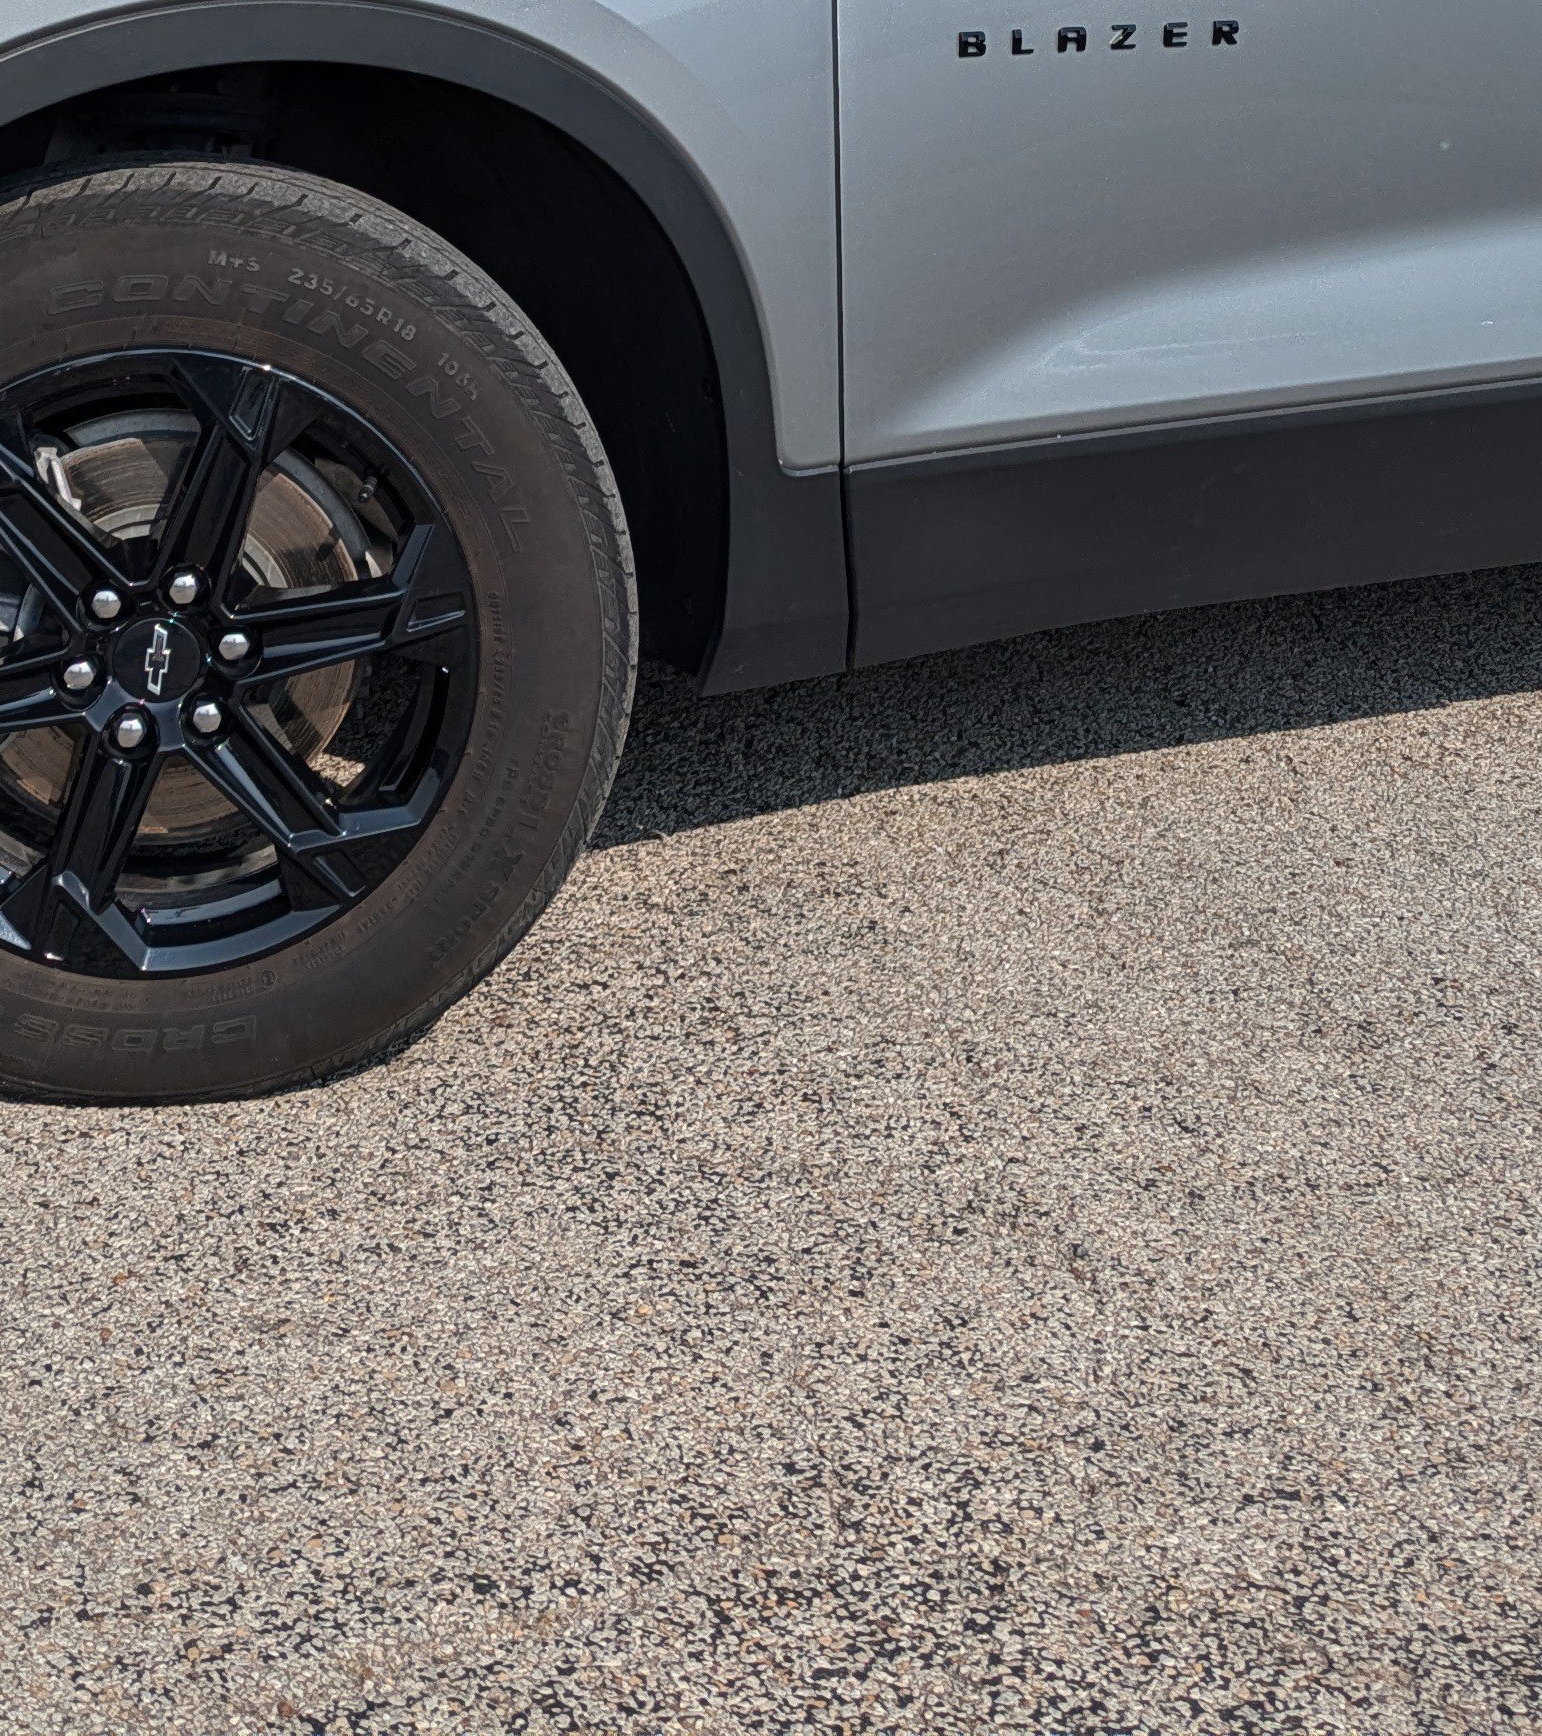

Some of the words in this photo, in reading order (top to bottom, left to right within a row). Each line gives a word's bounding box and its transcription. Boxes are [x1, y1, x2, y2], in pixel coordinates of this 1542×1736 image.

[958, 20, 1239, 58] BLAZER
[205, 245, 263, 275] M+S
[287, 265, 419, 345] 235/65R18
[45, 273, 526, 554] CONTINENTAL
